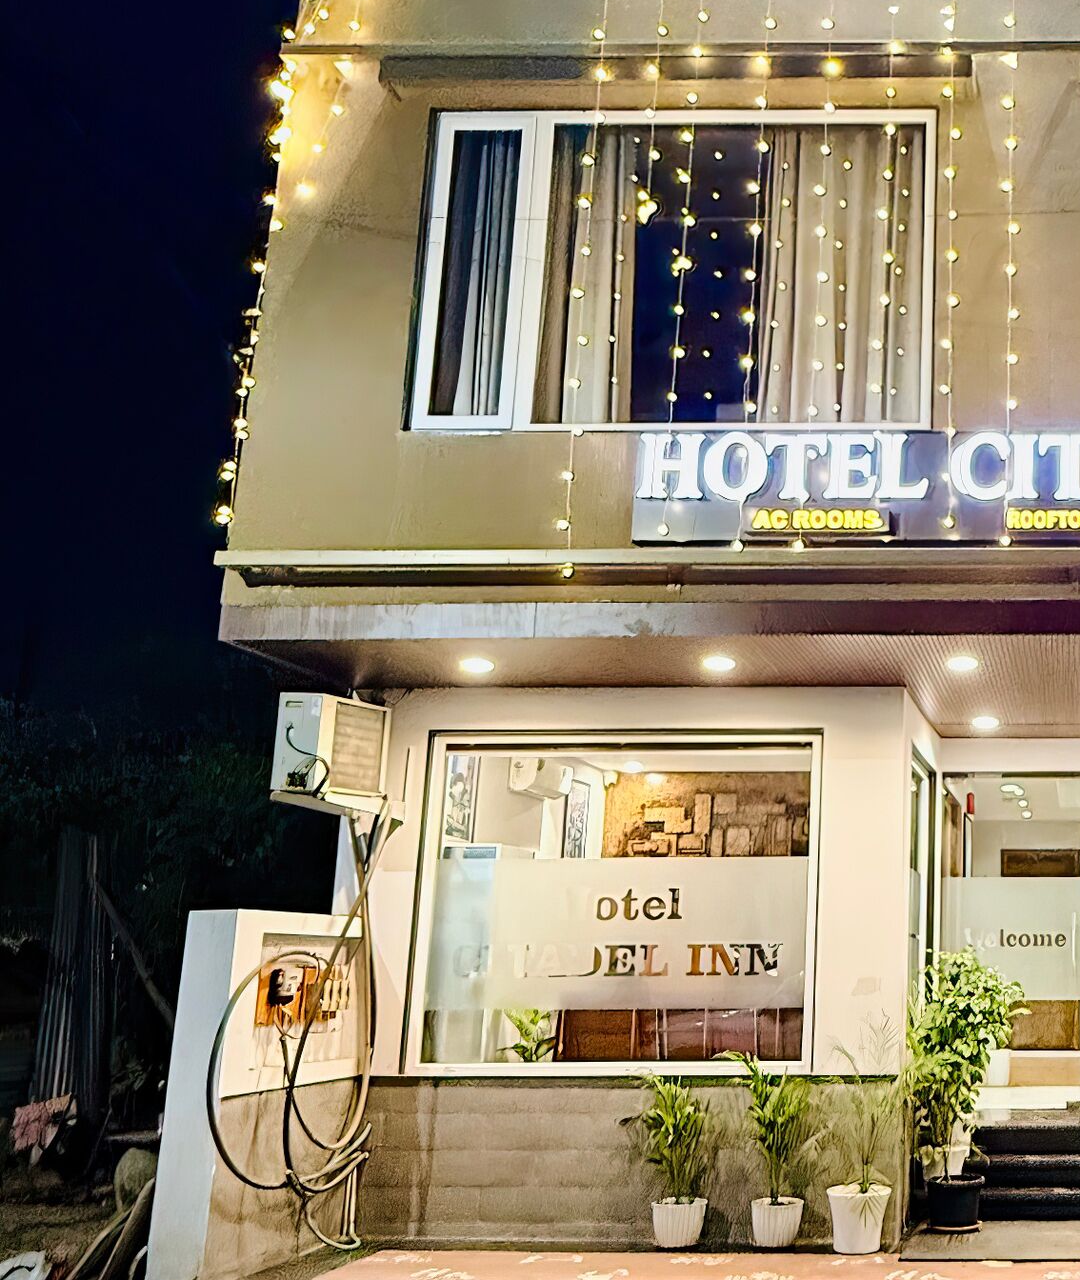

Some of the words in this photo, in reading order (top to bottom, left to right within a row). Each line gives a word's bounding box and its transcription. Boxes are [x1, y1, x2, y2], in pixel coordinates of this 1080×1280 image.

[635, 431, 929, 501] HOTEL
[751, 508, 789, 530] AC
[791, 508, 884, 530] ROOMS
[567, 886, 683, 921] otel
[685, 942, 785, 978] INN
